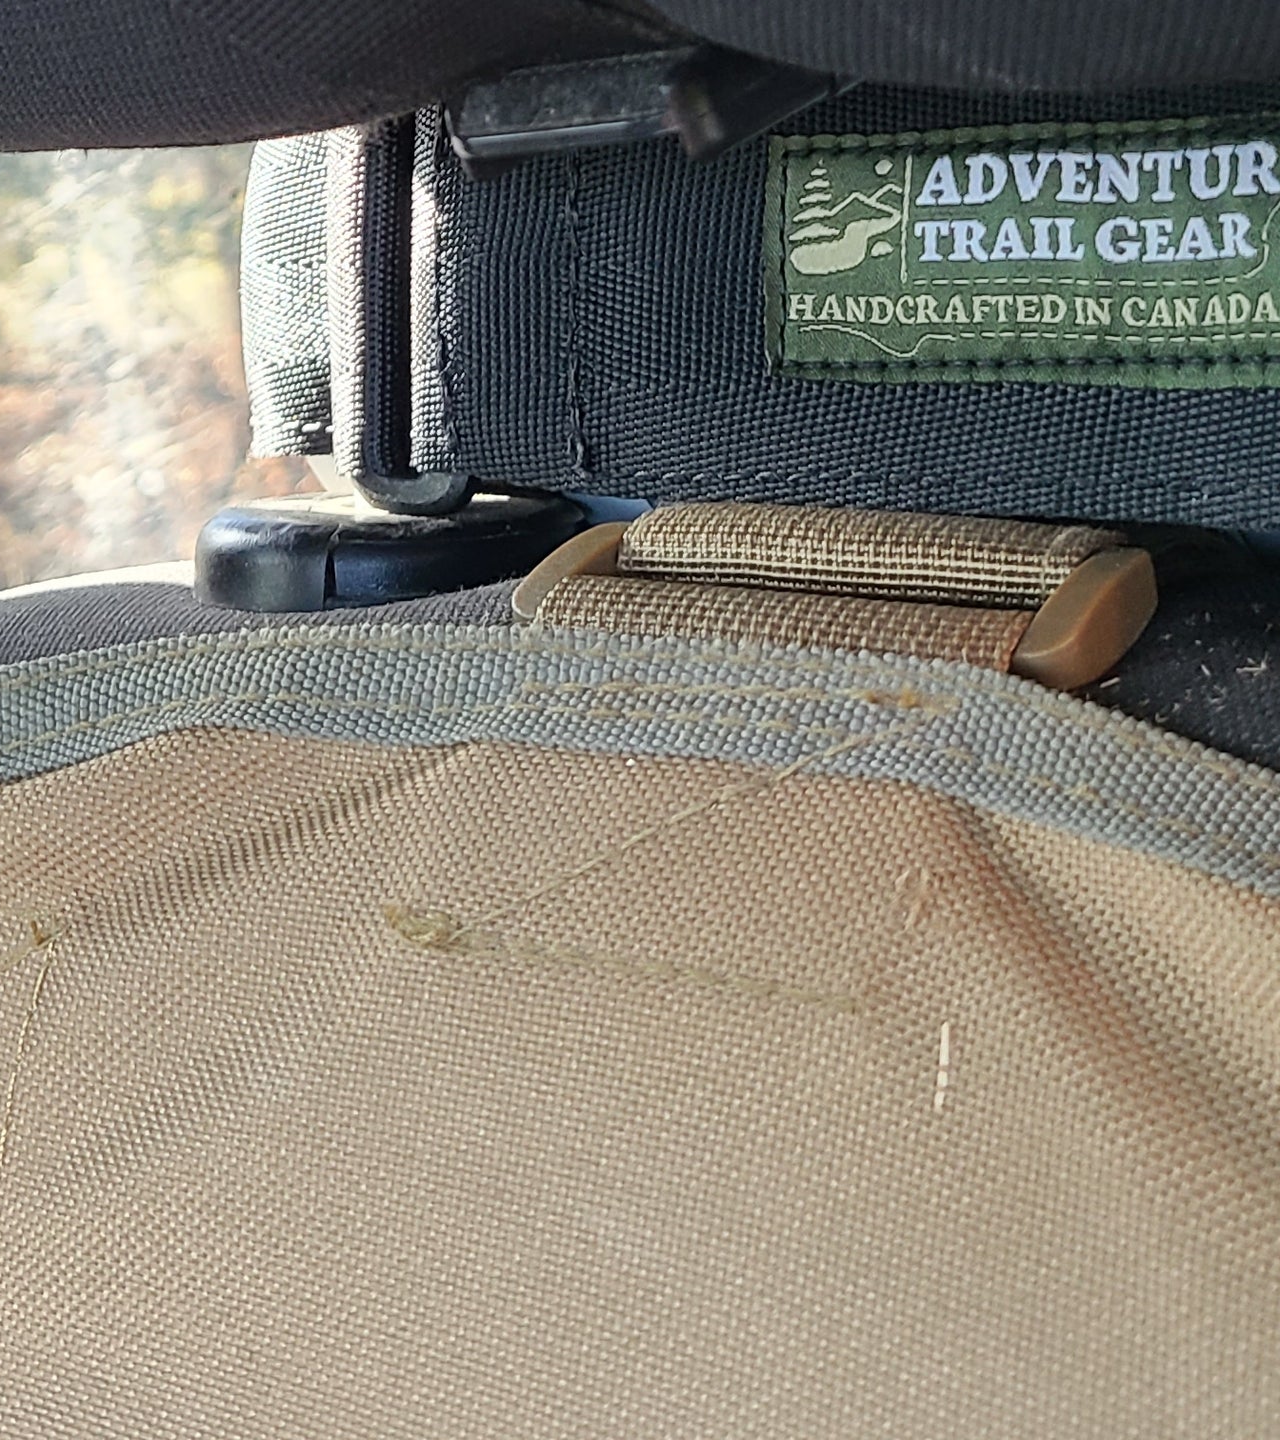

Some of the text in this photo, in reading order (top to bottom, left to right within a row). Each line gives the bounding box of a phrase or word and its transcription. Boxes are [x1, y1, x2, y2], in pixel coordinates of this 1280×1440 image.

[914, 212, 1257, 262] TRAIL GEAR
[788, 294, 1067, 325] HANDCRAFTED
[1074, 298, 1113, 324] IN
